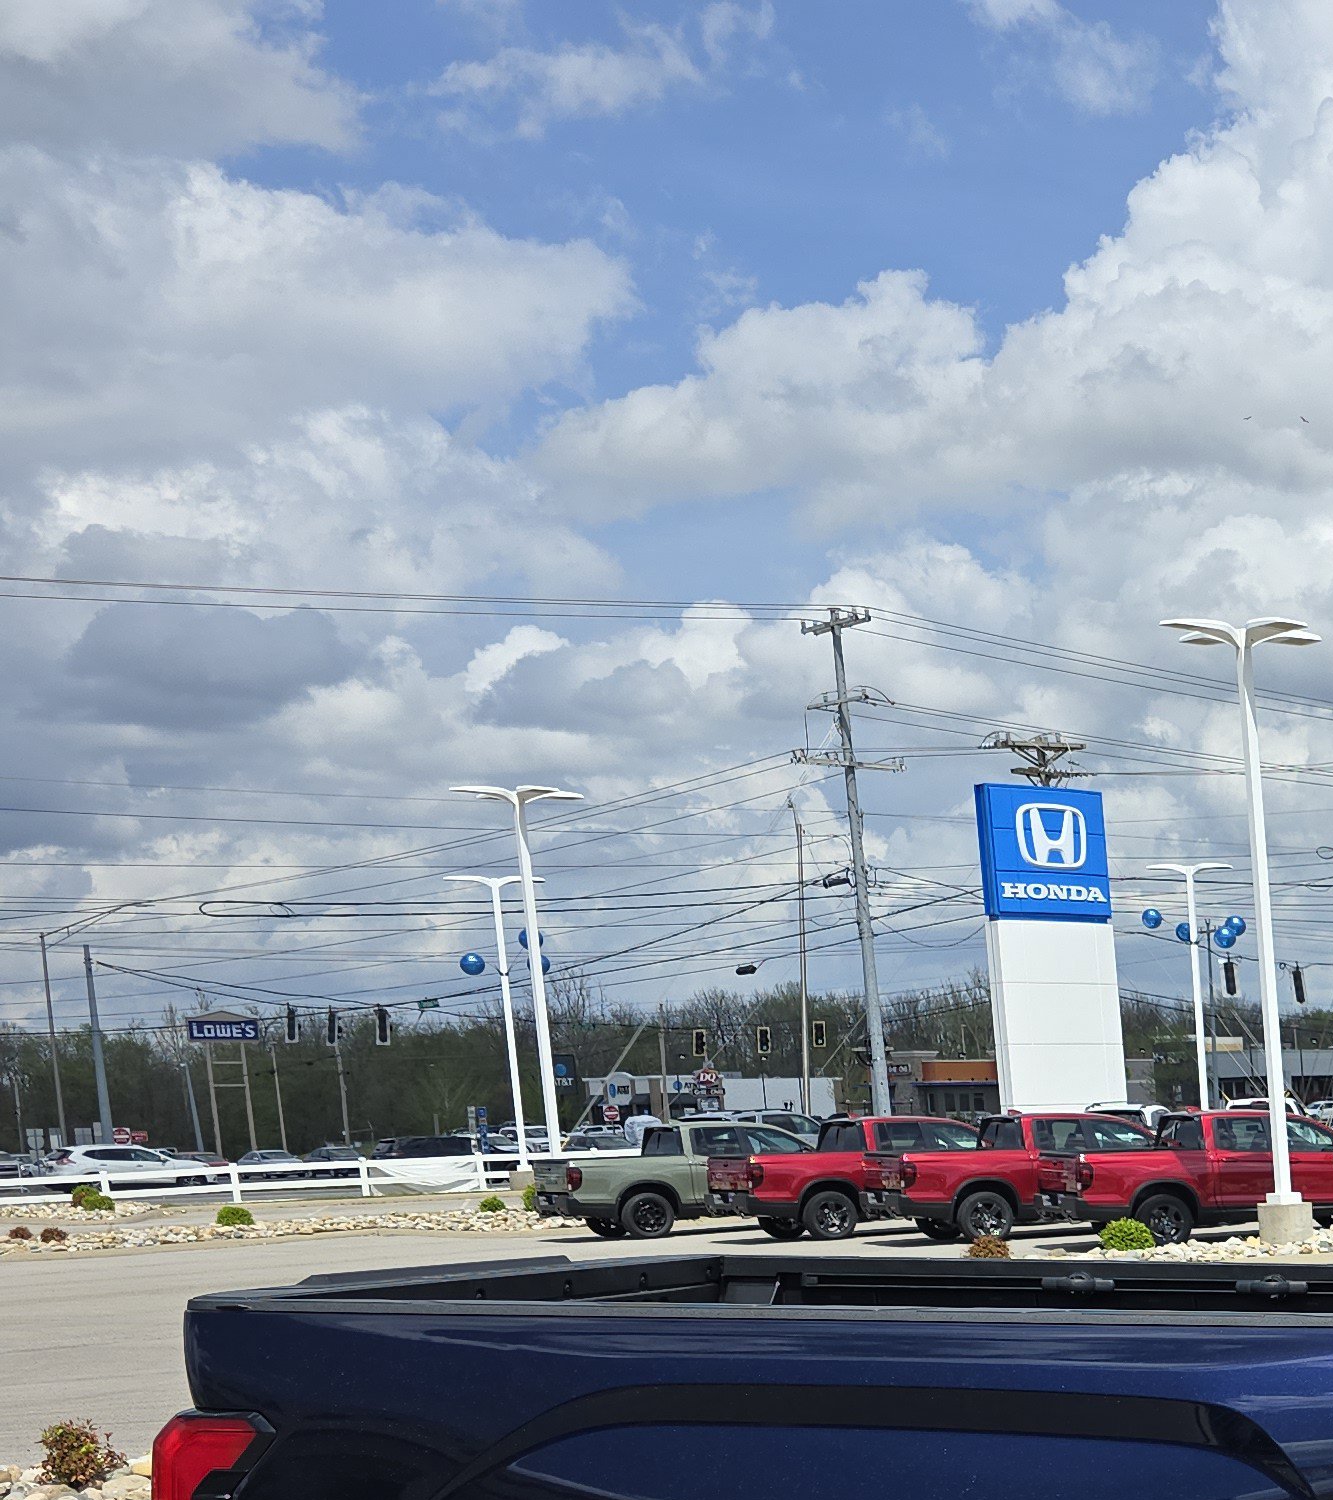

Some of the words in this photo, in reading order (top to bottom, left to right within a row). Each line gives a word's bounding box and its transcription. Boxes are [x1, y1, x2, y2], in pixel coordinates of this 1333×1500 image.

[1001, 882, 1107, 904] HONDA
[192, 1022, 256, 1038] LOWE'S
[700, 1072, 716, 1082] DQ
